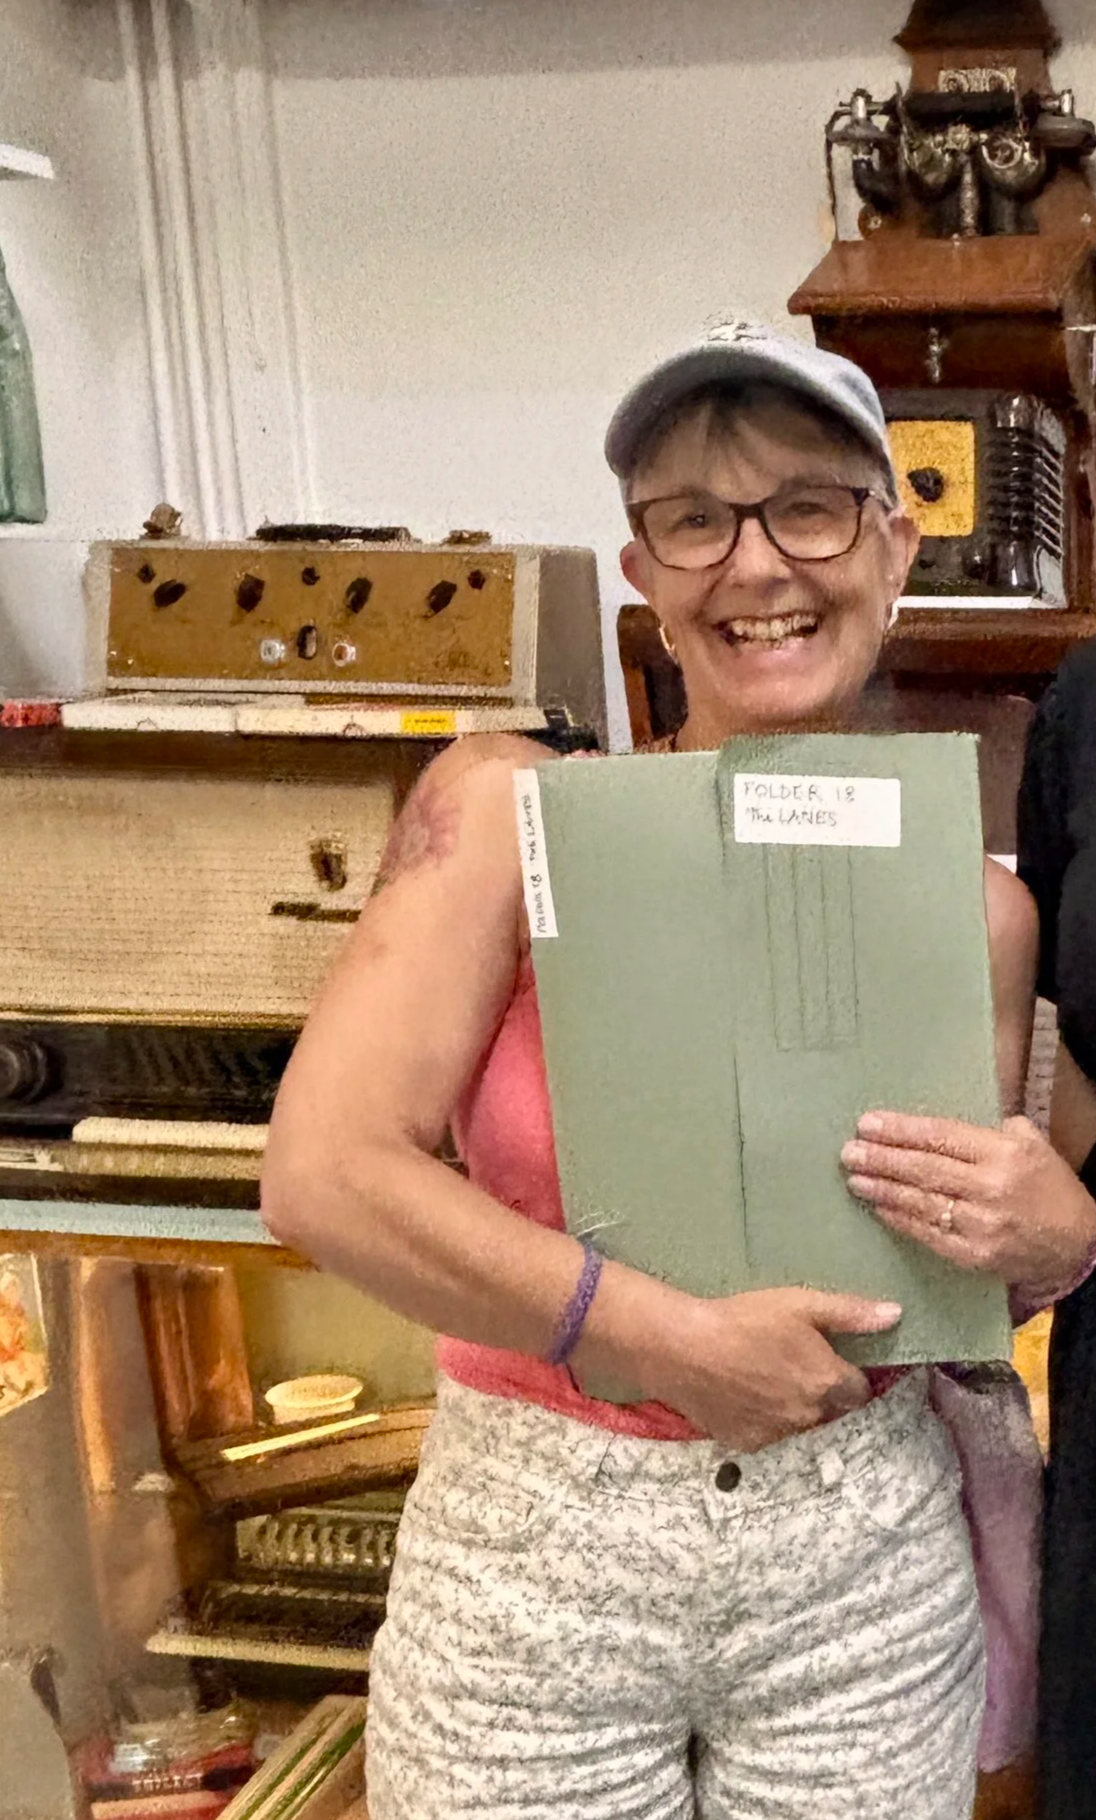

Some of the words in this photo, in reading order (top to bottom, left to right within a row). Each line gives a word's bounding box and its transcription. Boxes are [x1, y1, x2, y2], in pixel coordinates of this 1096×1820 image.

[744, 782, 823, 802] FOLDER
[836, 784, 856, 802] 18
[778, 807, 838, 827] LANES
